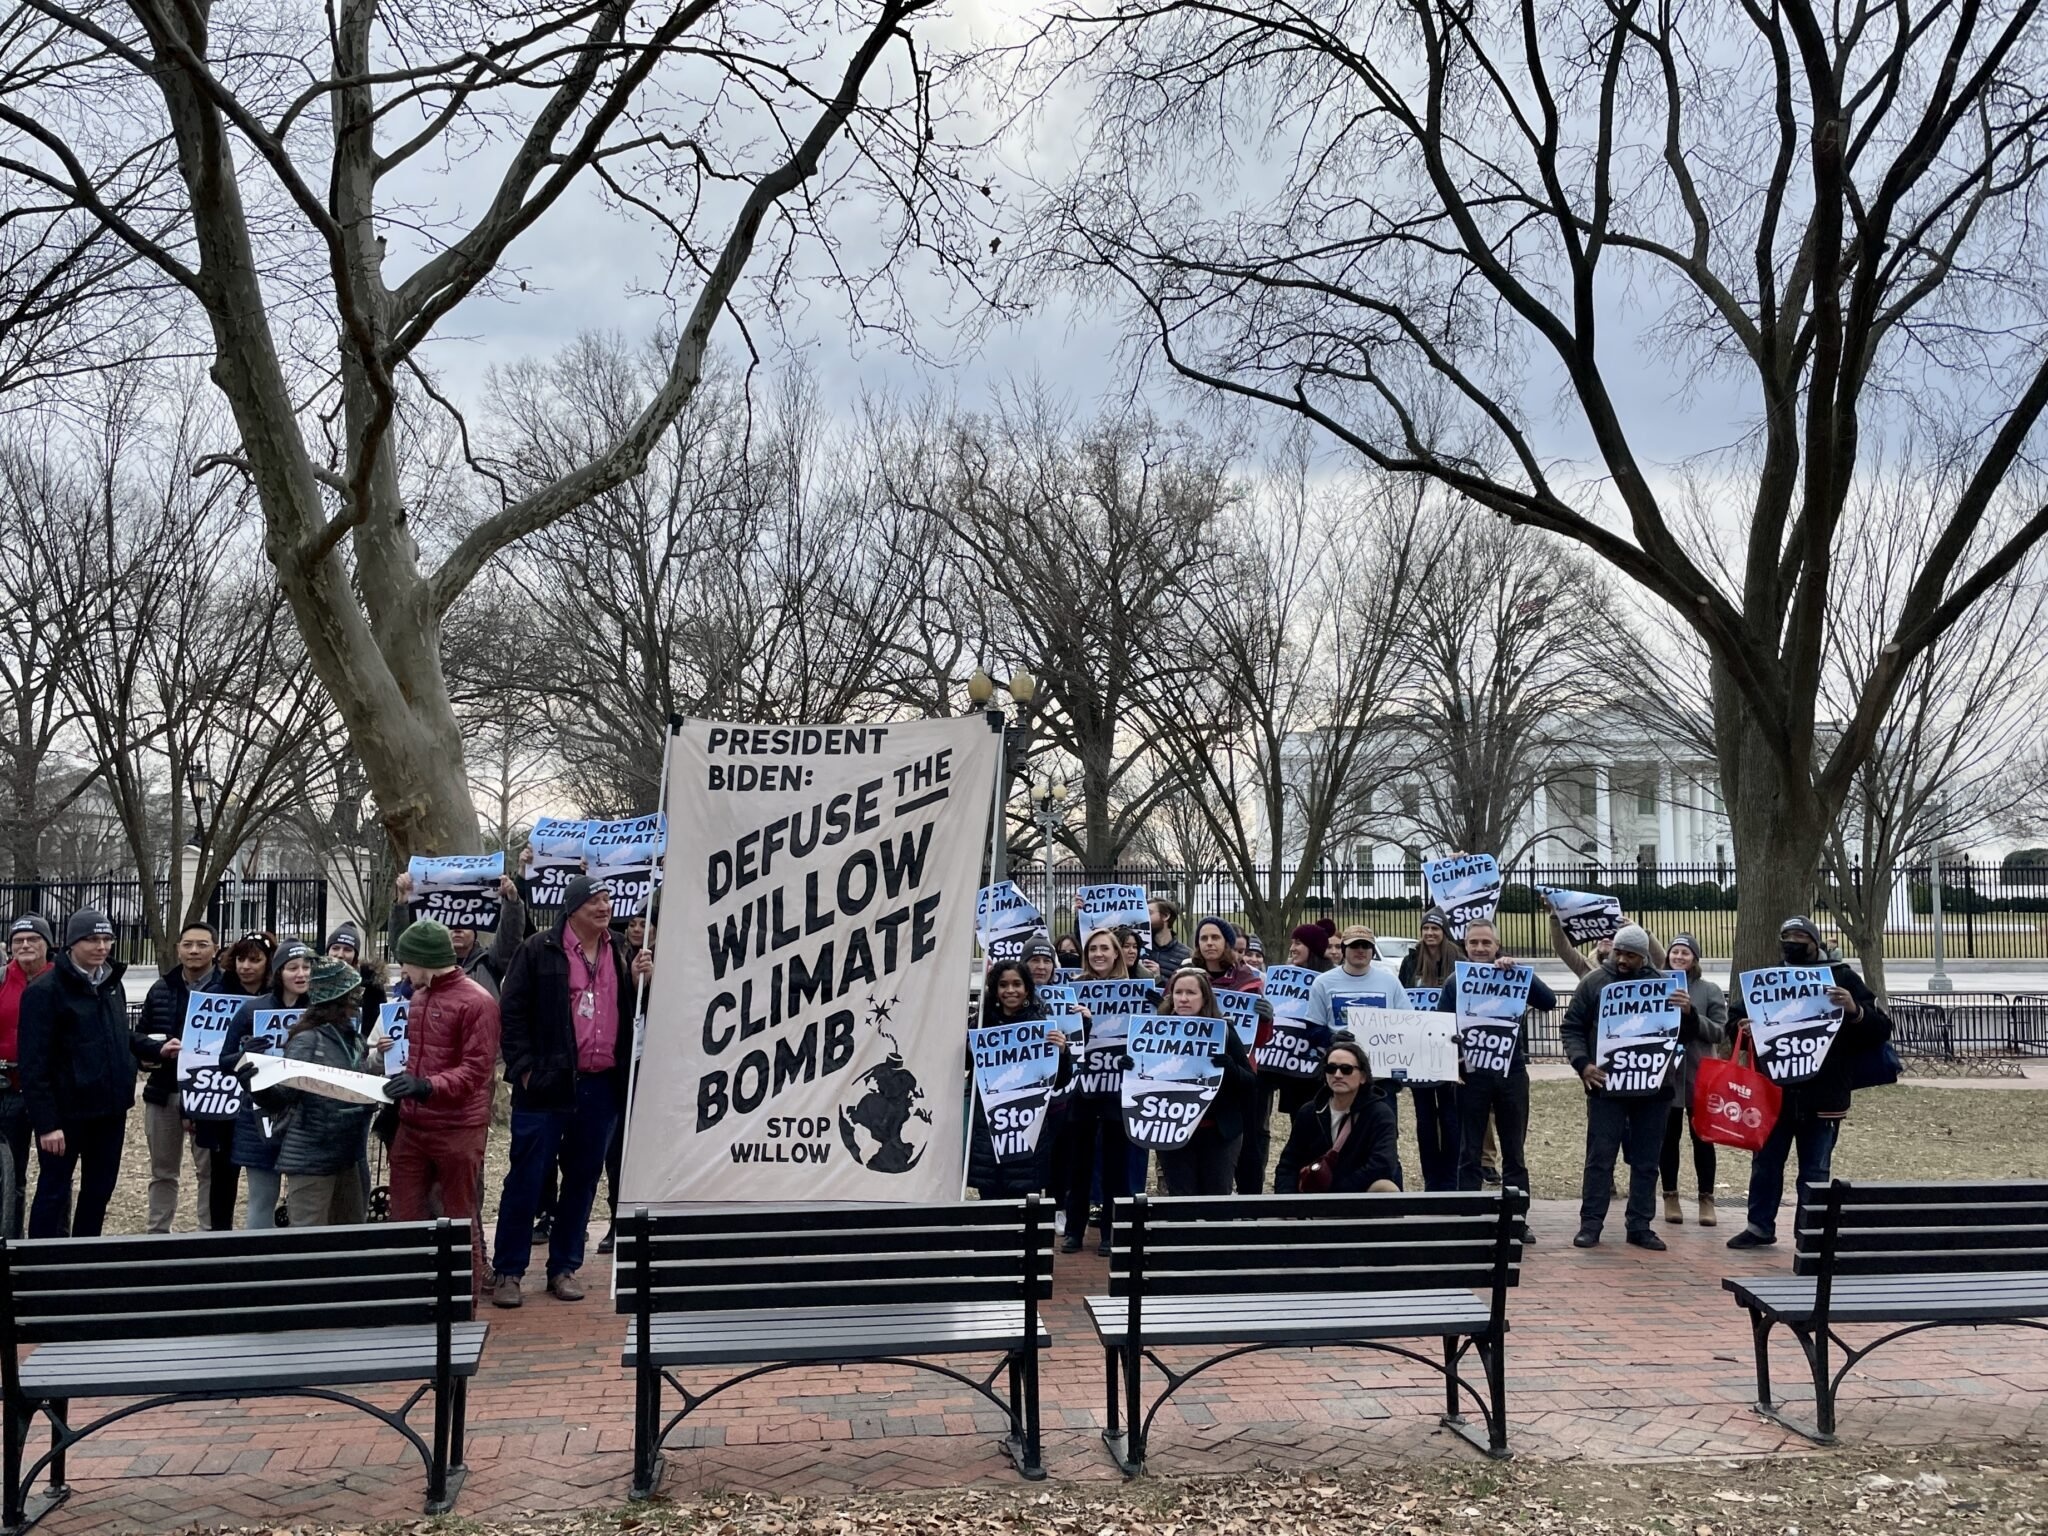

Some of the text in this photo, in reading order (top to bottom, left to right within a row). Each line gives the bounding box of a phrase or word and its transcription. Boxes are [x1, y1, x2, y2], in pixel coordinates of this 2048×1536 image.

[707, 728, 888, 755] PRESIDENT
[708, 765, 813, 791] BIDEN:
[546, 821, 583, 830] ACT
[596, 817, 658, 834] ACT ON
[708, 748, 952, 906] DEFUSE THE
[588, 832, 664, 845] CLIMATE
[1431, 861, 1493, 884] CLIMATE
[427, 893, 483, 912] Stop
[531, 886, 566, 904] Wil
[707, 821, 934, 981] WILLOW
[1086, 887, 1137, 901] ACT ON
[978, 897, 1027, 914] CIMA
[1083, 900, 1144, 914] CLIMATE
[1453, 903, 1493, 923] Stop
[415, 909, 495, 926] Willow
[1569, 917, 1609, 930] Stop
[1569, 928, 1617, 941] Willo
[702, 890, 941, 1055] CLIMATE
[1271, 969, 1302, 983] ACT
[1466, 967, 1528, 983] ACT ON
[1752, 971, 1821, 988] ACT ON
[1040, 989, 1066, 999] ON
[1078, 984, 1145, 999] ACT ON
[1462, 981, 1528, 999] CLIMATE
[1606, 982, 1666, 1001] ACT ON
[199, 998, 241, 1014] ACT
[1223, 994, 1250, 1010] ON
[1602, 998, 1675, 1018] CLIMATE
[976, 1025, 1045, 1049] ACT ON
[1140, 1020, 1214, 1038] ACT ON
[1132, 1038, 1219, 1057] CLIMATE
[1465, 1029, 1512, 1055] Stop
[976, 1041, 1054, 1069] CLIMATE
[1255, 1047, 1319, 1073] Willow
[1613, 1051, 1666, 1072] Stop
[696, 1009, 854, 1133] BOMB
[182, 1089, 240, 1114] Willo
[1140, 1096, 1200, 1124] Stop
[767, 1117, 830, 1138] STOP
[730, 1143, 831, 1164] WILLOW
